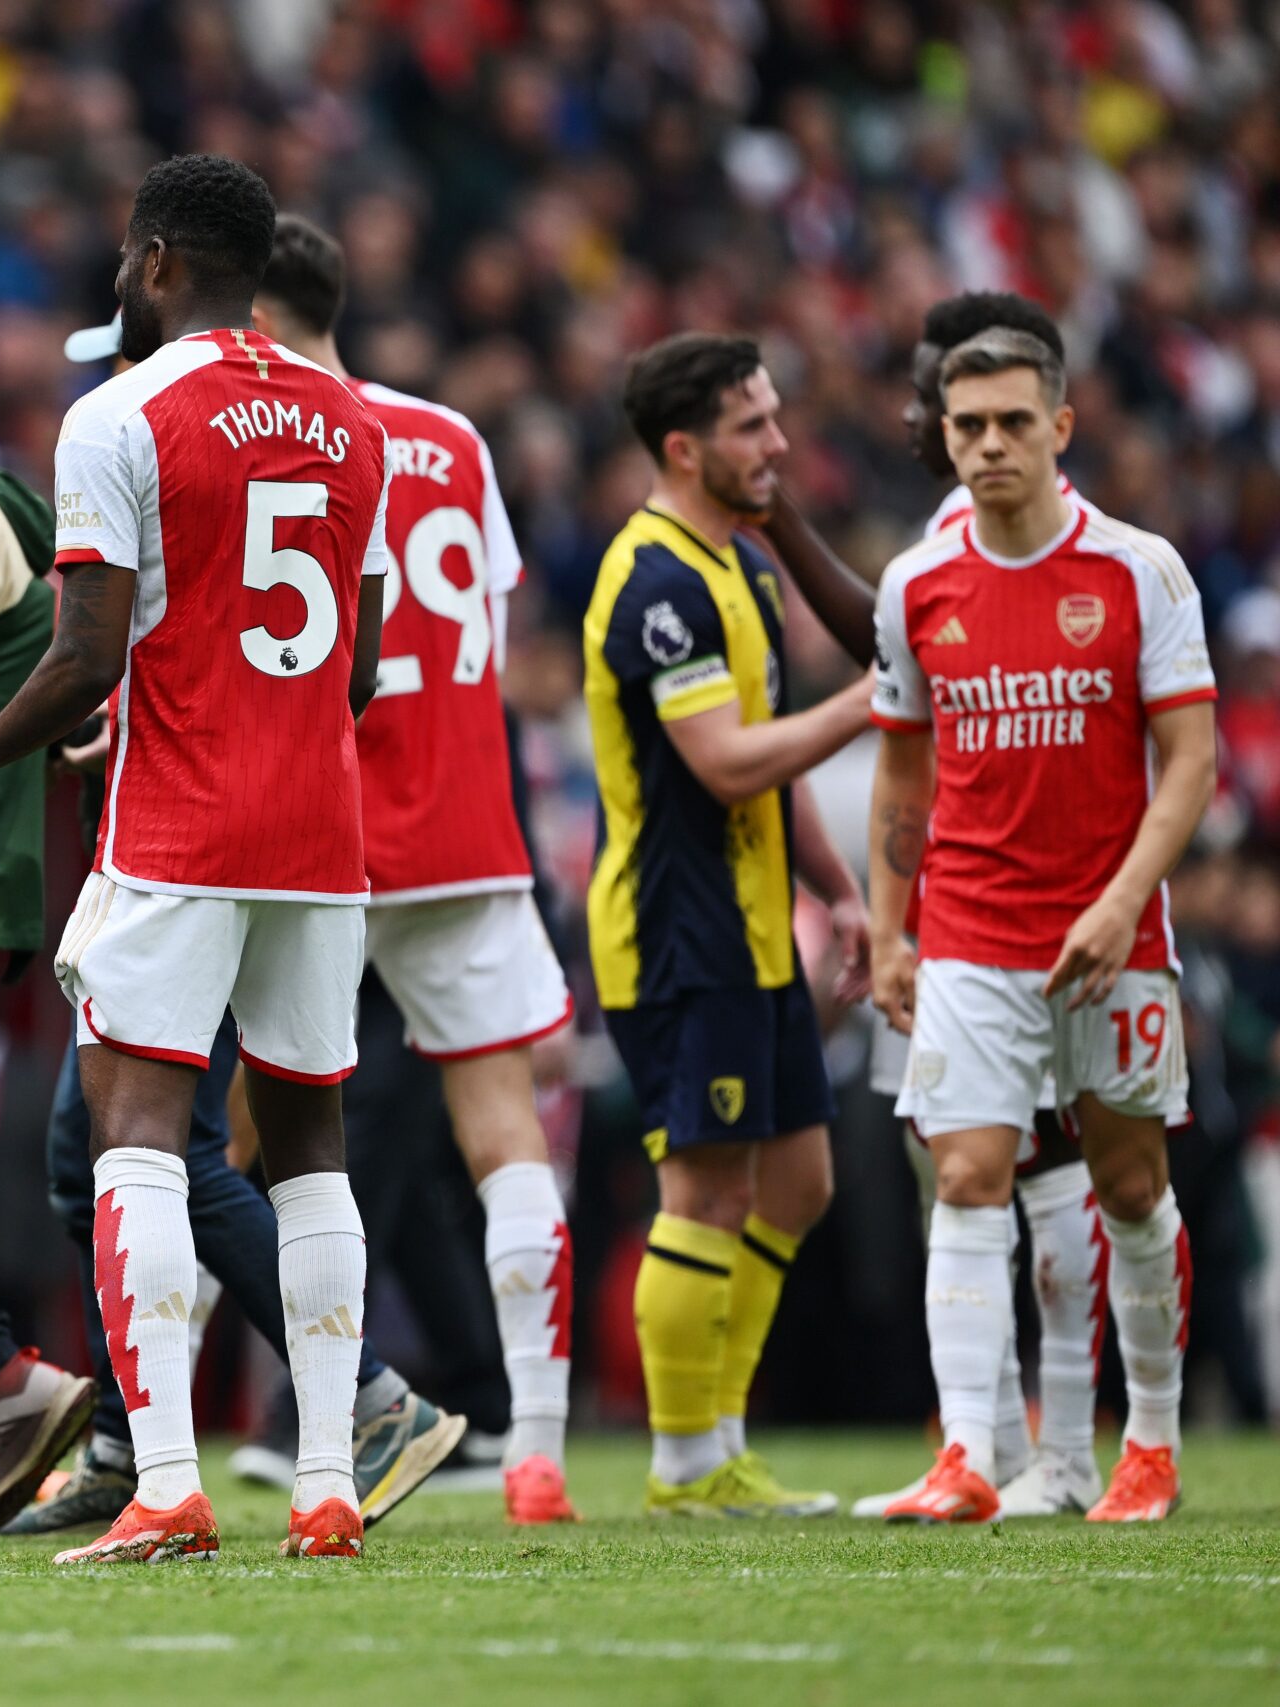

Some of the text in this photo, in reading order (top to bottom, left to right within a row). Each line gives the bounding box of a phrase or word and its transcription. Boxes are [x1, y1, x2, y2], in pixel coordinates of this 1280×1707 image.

[209, 400, 350, 463] THOMAS
[391, 437, 454, 486] RTZ
[57, 511, 104, 530] ANDA
[60, 492, 83, 510] SIT
[239, 480, 339, 677] 5
[930, 664, 1113, 714] Emirates
[956, 708, 1086, 753] FLY BETTER
[1109, 1002, 1166, 1073] 19
